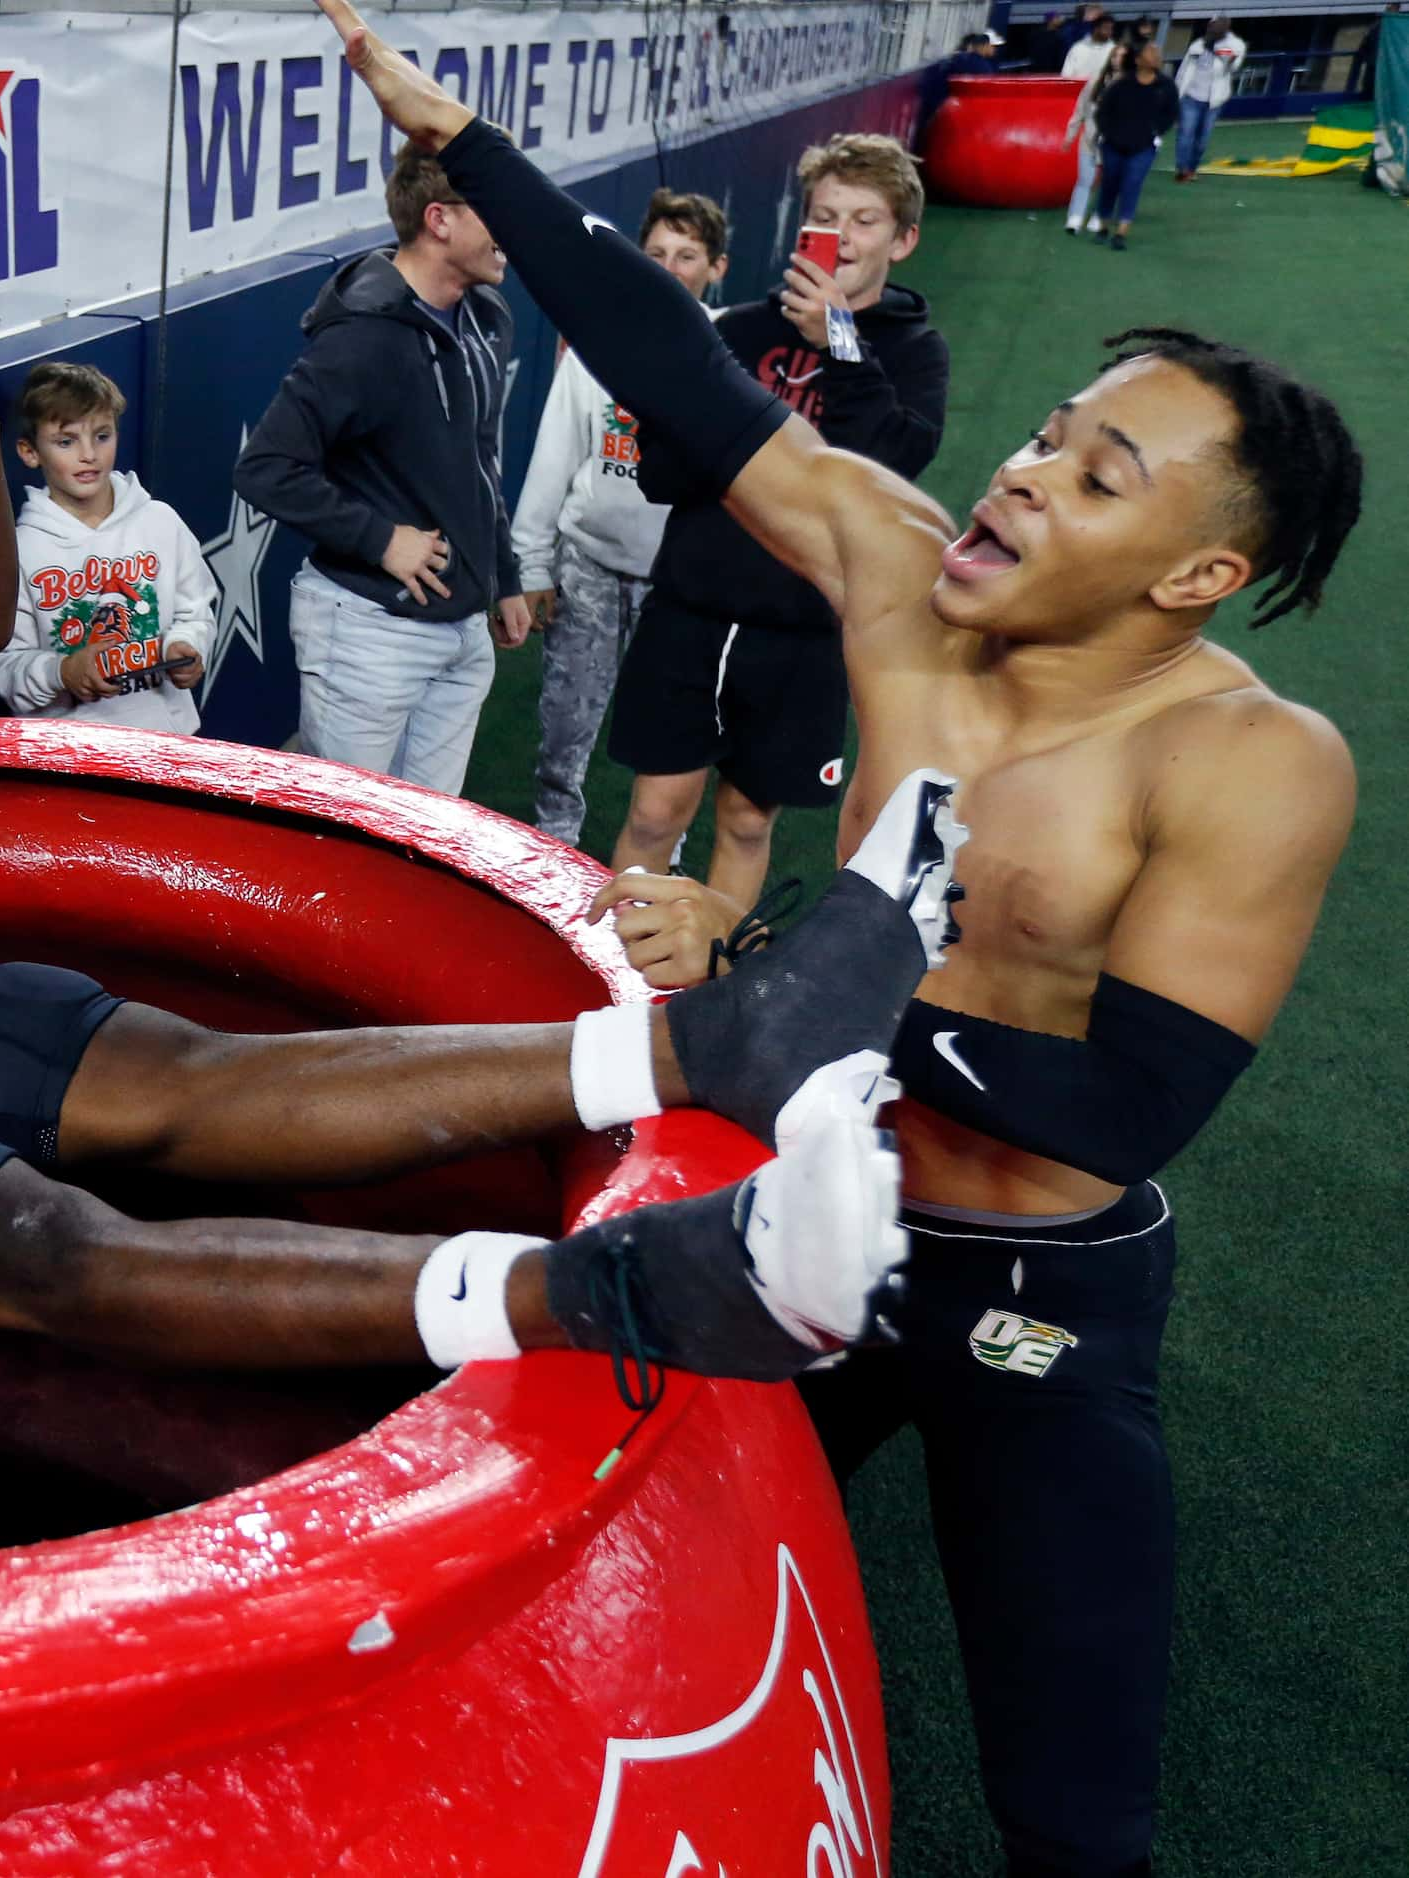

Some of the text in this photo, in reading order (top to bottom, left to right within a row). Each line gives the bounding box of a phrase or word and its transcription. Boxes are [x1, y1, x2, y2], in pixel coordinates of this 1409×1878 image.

[567, 38, 615, 140] TO
[629, 33, 686, 125] THE
[29, 551, 161, 611] Believe
[65, 622, 82, 642] in
